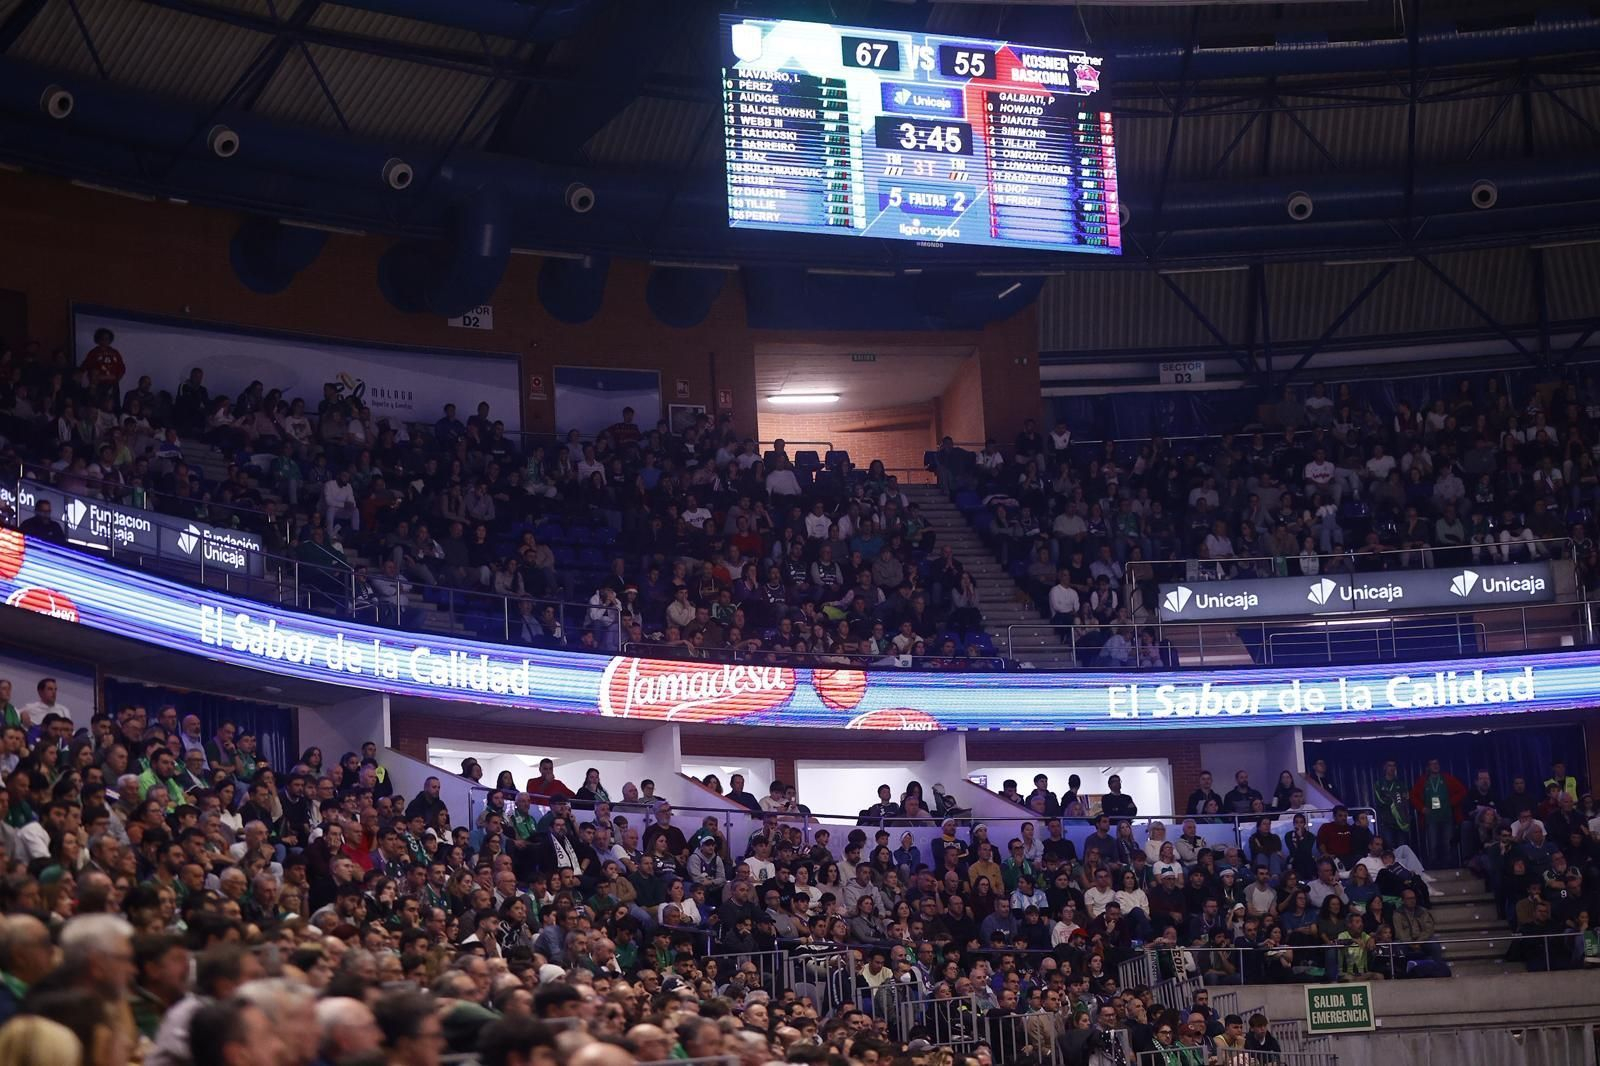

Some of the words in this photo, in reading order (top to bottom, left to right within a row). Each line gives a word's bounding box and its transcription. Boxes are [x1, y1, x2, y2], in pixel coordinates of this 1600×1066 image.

[855, 42, 889, 67] 67
[904, 44, 935, 71] VS
[953, 51, 985, 76] 55
[1022, 54, 1068, 71] KOSNER
[1011, 67, 1070, 86] BASKONIA
[726, 81, 733, 89] 0
[739, 79, 773, 92] PÉREZ
[727, 93, 733, 101] 1
[739, 92, 779, 104] AUDIGE
[912, 95, 951, 110] Unicaja
[999, 92, 1046, 105] GALBIATI,
[1048, 95, 1055, 104] P
[728, 103, 734, 112] 2
[740, 104, 816, 119] BALCEROWSKI
[988, 103, 993, 111] 0
[999, 104, 1043, 115] HOWARD
[728, 115, 735, 124] 3
[740, 115, 772, 126] WEBB
[989, 115, 994, 123] 1
[1000, 115, 1038, 126] DIAKITE
[741, 128, 797, 141] KALINOSKI
[900, 123, 962, 153] 3:45
[989, 126, 995, 135] 2
[1001, 127, 1046, 138] SIMMONS
[1002, 138, 1036, 149] VILLAR
[1101, 135, 1112, 145] 10
[1005, 184, 1029, 194] DIOP
[888, 187, 902, 207] 5
[908, 192, 947, 207] FALTAS
[953, 192, 965, 211] 2
[1006, 196, 1041, 206] FRISCH
[745, 211, 780, 222] PERRY
[463, 316, 480, 327] D2
[1162, 362, 1201, 371] SECTOR
[1174, 373, 1192, 384] D3
[203, 543, 245, 568] Unicaja
[1482, 575, 1545, 595] Unicaja
[1339, 583, 1403, 603] Unicaja
[1195, 591, 1258, 611] Unicaja
[201, 604, 223, 646] El
[232, 614, 314, 665] Sabor
[325, 633, 362, 673] de
[374, 639, 399, 680] la
[410, 648, 531, 696] Calidad
[1107, 684, 1138, 718] El
[1152, 682, 1262, 718] Sabor
[1277, 679, 1325, 714] de
[1339, 677, 1372, 711] la
[1386, 667, 1535, 709] Calidad
[1560, 889, 1568, 898] 9
[1313, 994, 1346, 1009] SALIDA
[1351, 993, 1364, 1006] DE
[1311, 1009, 1369, 1024] EMERGENCIA
